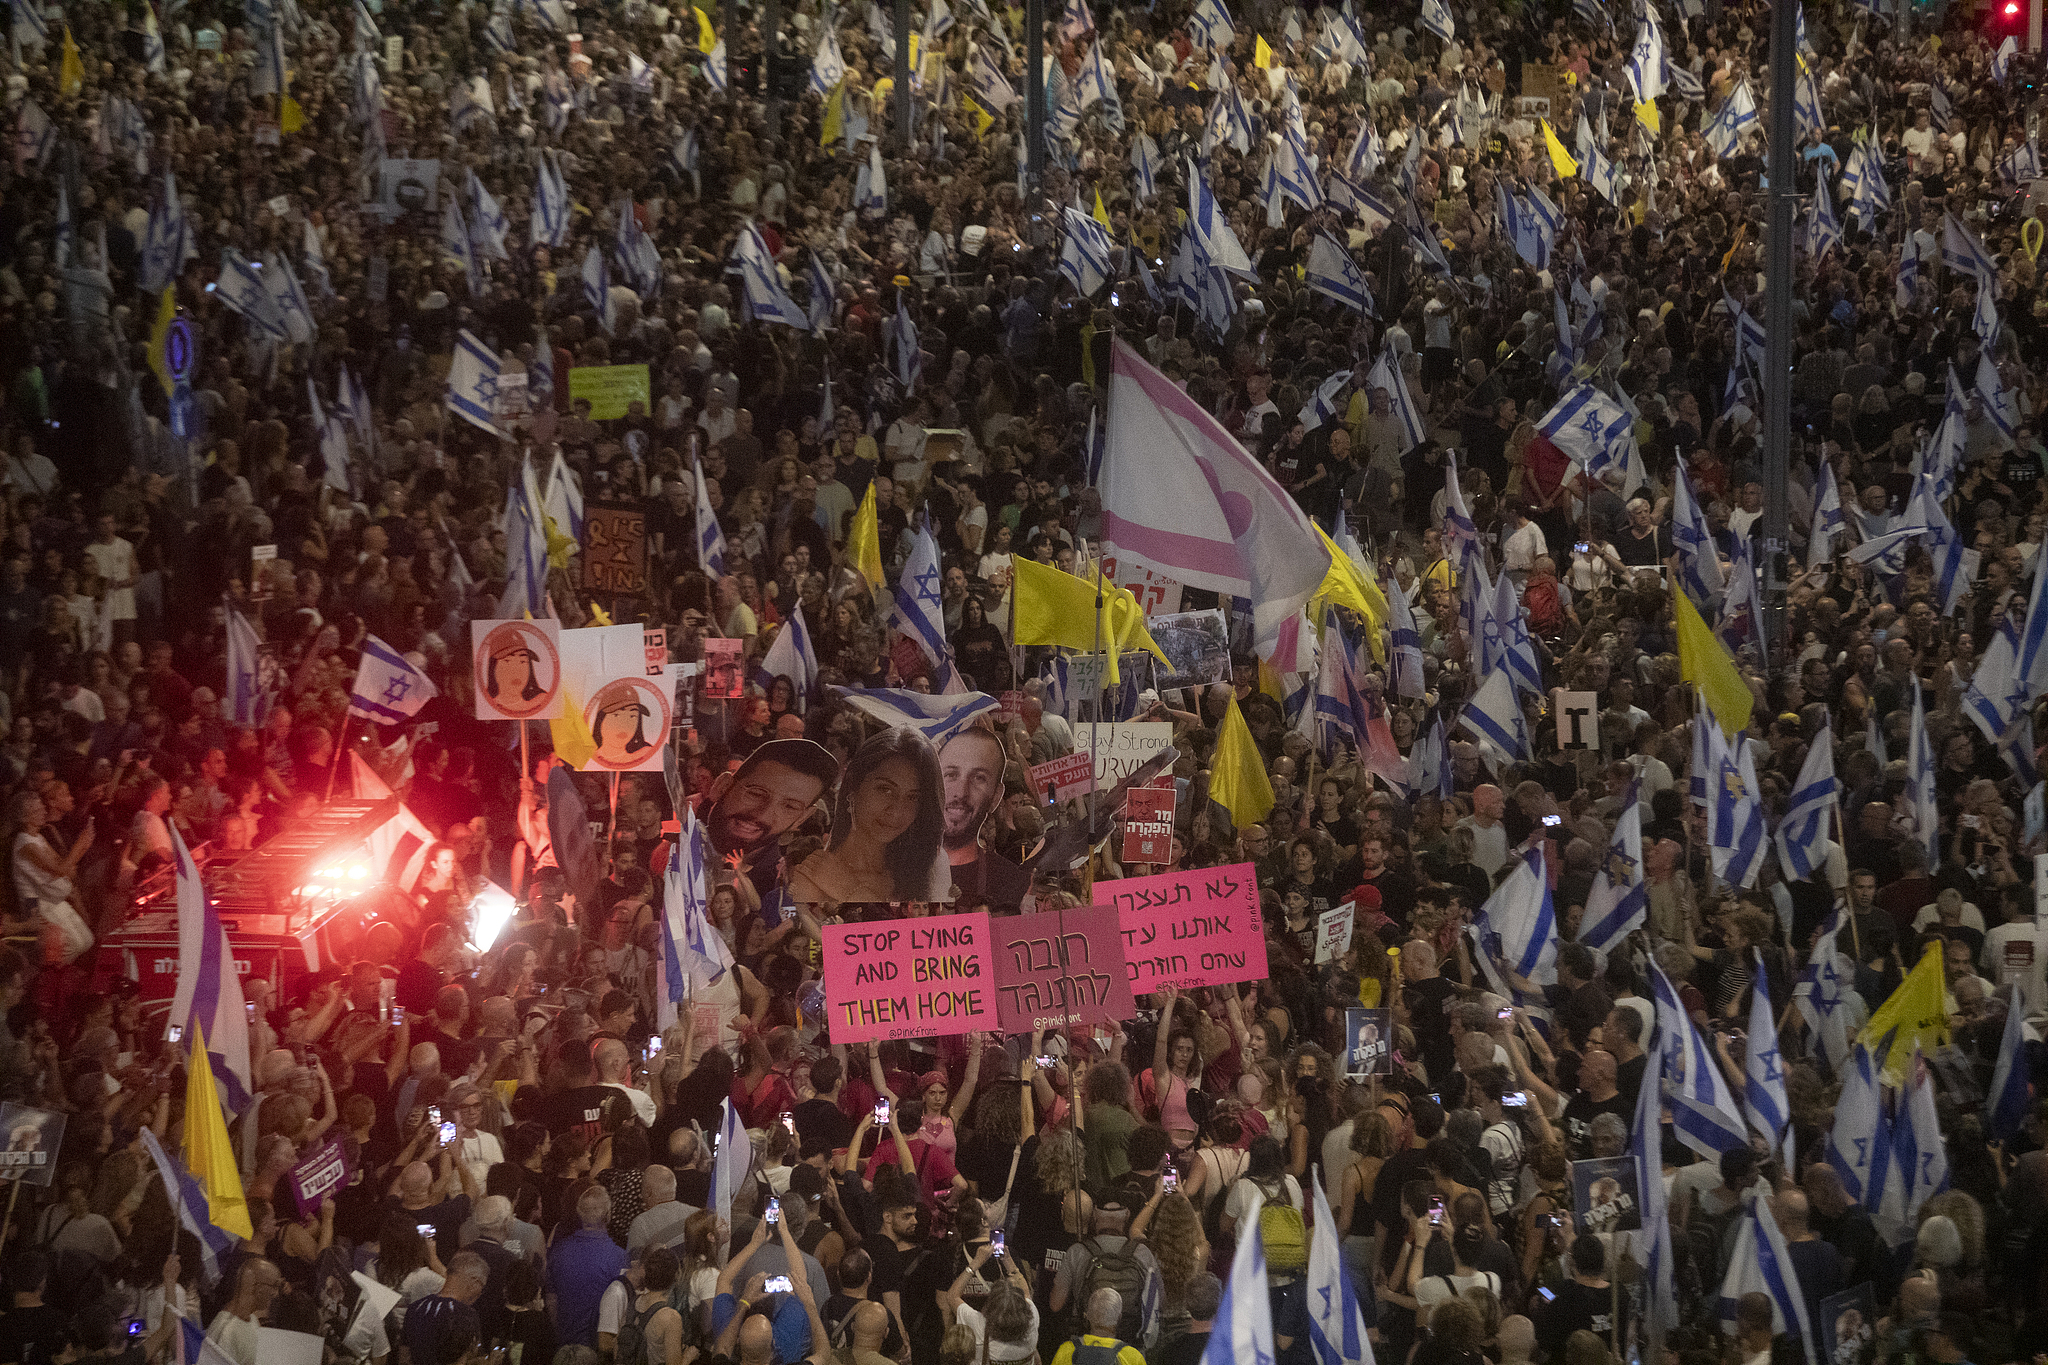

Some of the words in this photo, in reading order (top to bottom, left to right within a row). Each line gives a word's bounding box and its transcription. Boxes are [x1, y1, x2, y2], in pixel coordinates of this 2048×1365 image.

[1069, 752, 1090, 765] קול
[1205, 876, 1239, 900] לא
[844, 929, 900, 955] STOP
[911, 925, 974, 950] LYING
[1120, 922, 1157, 948] עד
[1172, 915, 1232, 941] אותנו
[1006, 931, 1091, 974] חובה
[1201, 951, 1246, 971] שהם
[856, 961, 899, 986] AND
[912, 954, 981, 983] BRING
[1125, 955, 1188, 981] חוזרים
[999, 967, 1113, 1015] להתנגד
[838, 995, 911, 1026] THEM
[916, 990, 985, 1019] HOME
